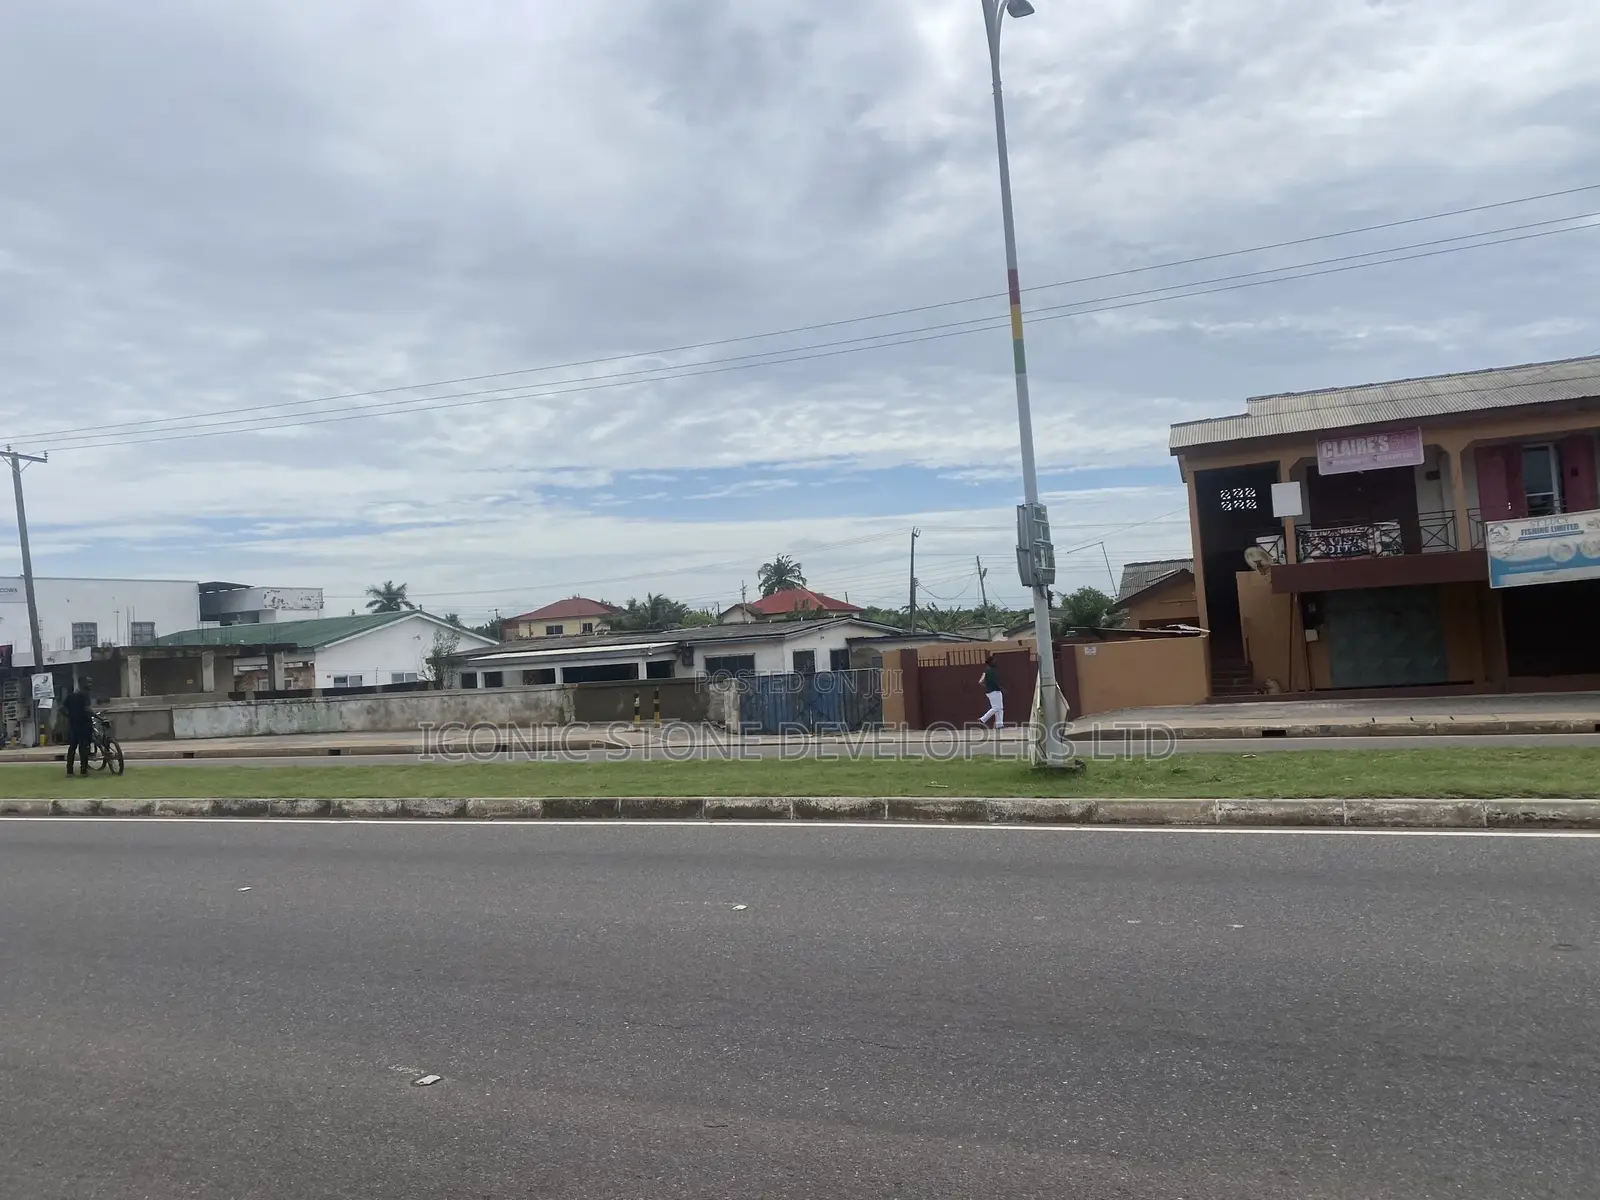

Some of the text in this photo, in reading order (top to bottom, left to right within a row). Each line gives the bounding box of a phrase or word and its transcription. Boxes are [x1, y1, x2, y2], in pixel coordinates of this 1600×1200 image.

[1321, 435, 1390, 458] CLAIRE'S
[1521, 522, 1580, 536] FISHING LIMITED
